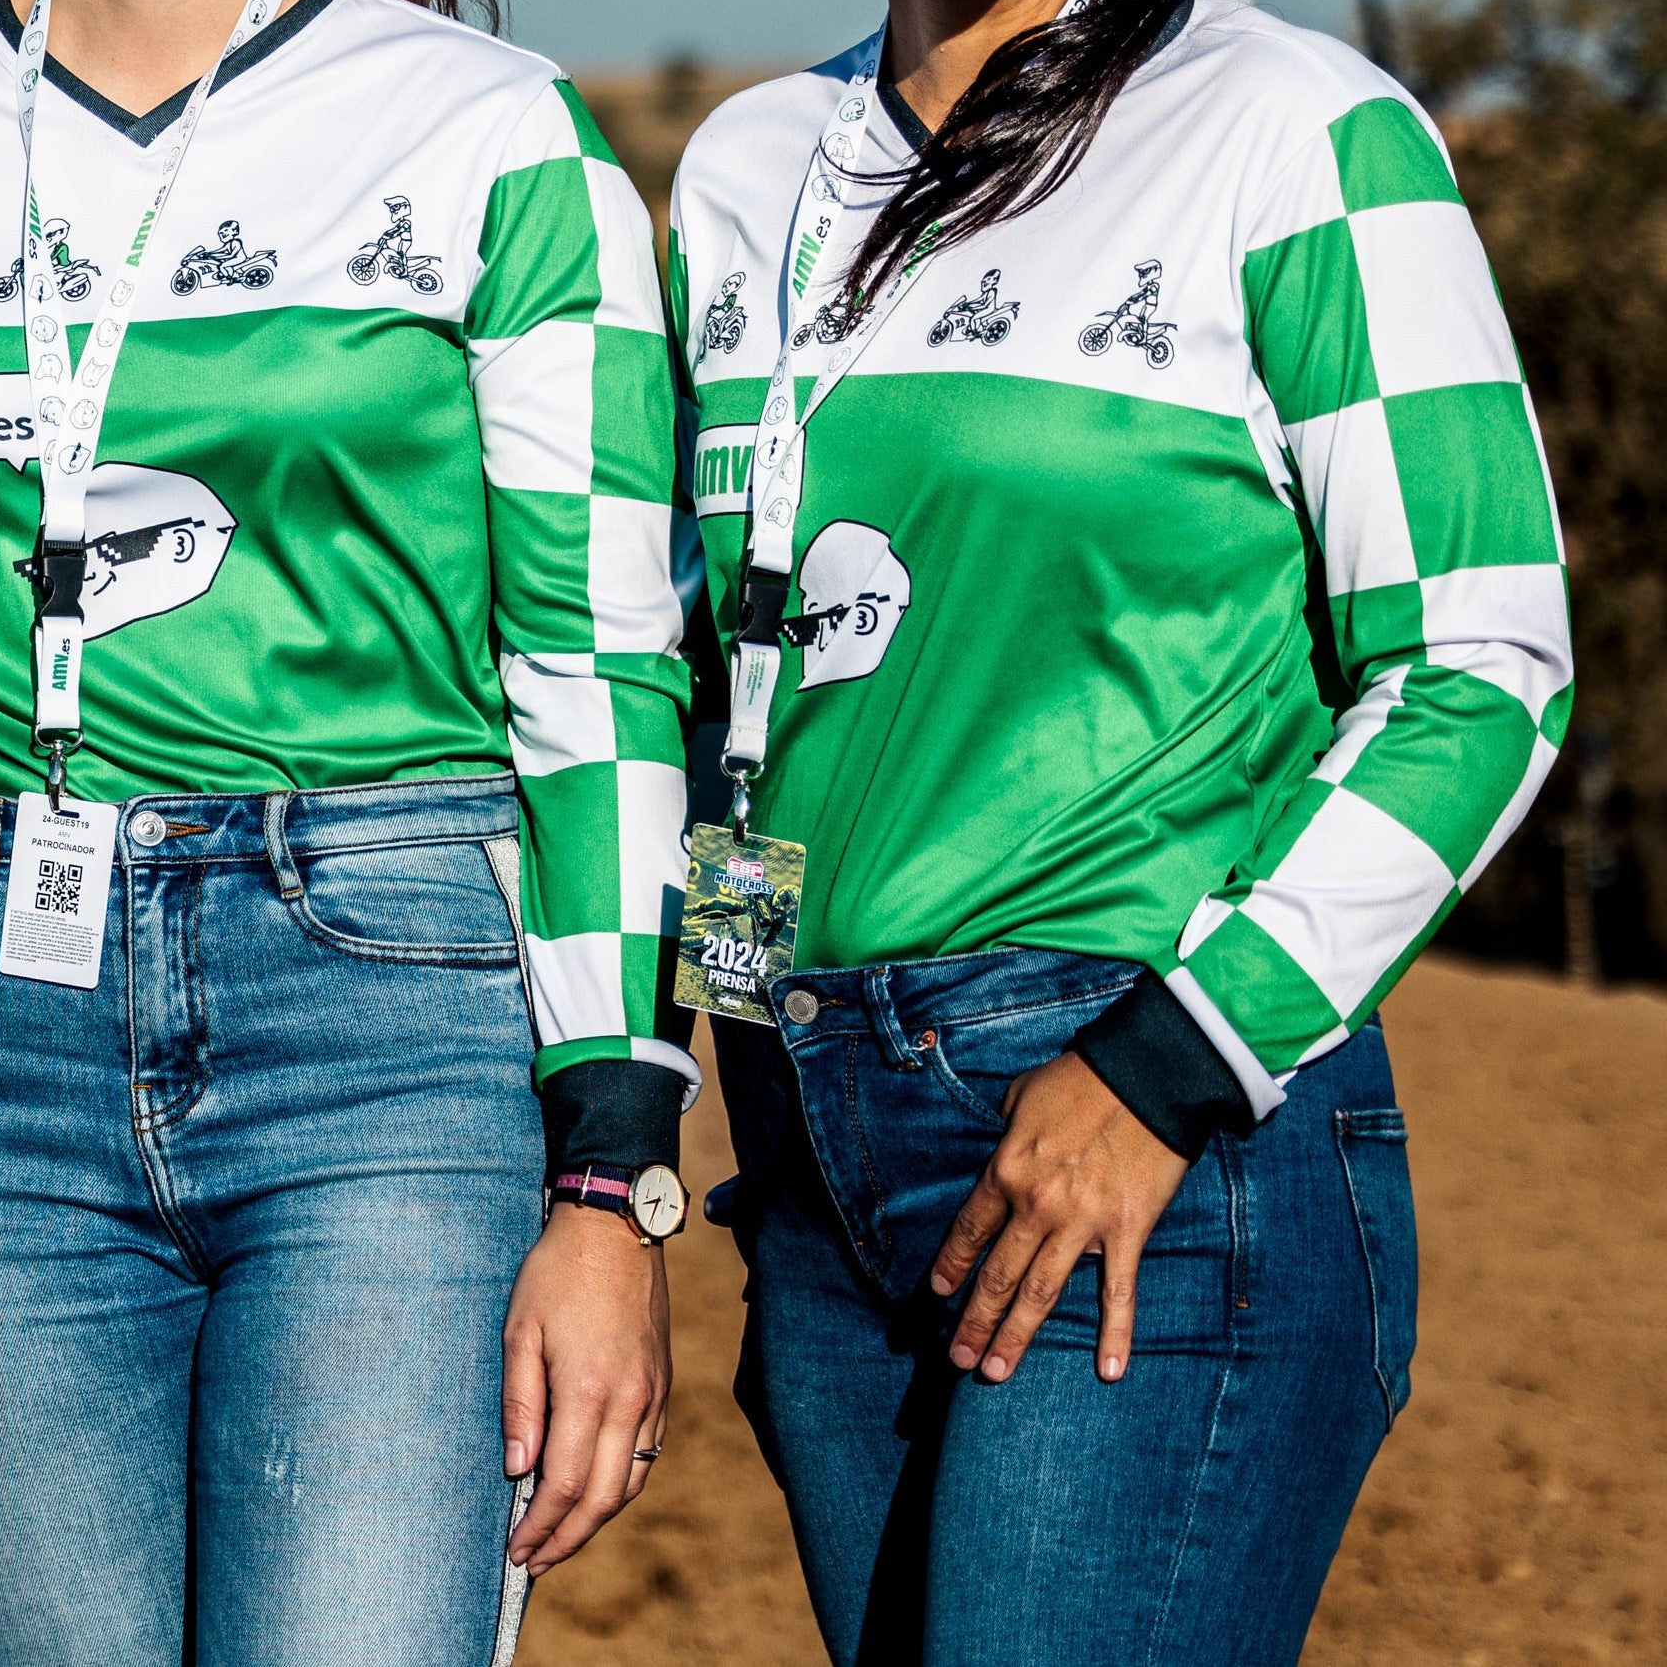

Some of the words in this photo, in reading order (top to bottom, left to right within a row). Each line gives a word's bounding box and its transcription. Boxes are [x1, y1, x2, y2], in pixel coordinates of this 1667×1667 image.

[42, 815, 90, 830] 24-GUEST19
[31, 837, 95, 856] PATROCINADOR
[714, 873, 773, 894] MOTOCROSS
[701, 935, 768, 974] 2024
[708, 969, 756, 993] PRENSA
